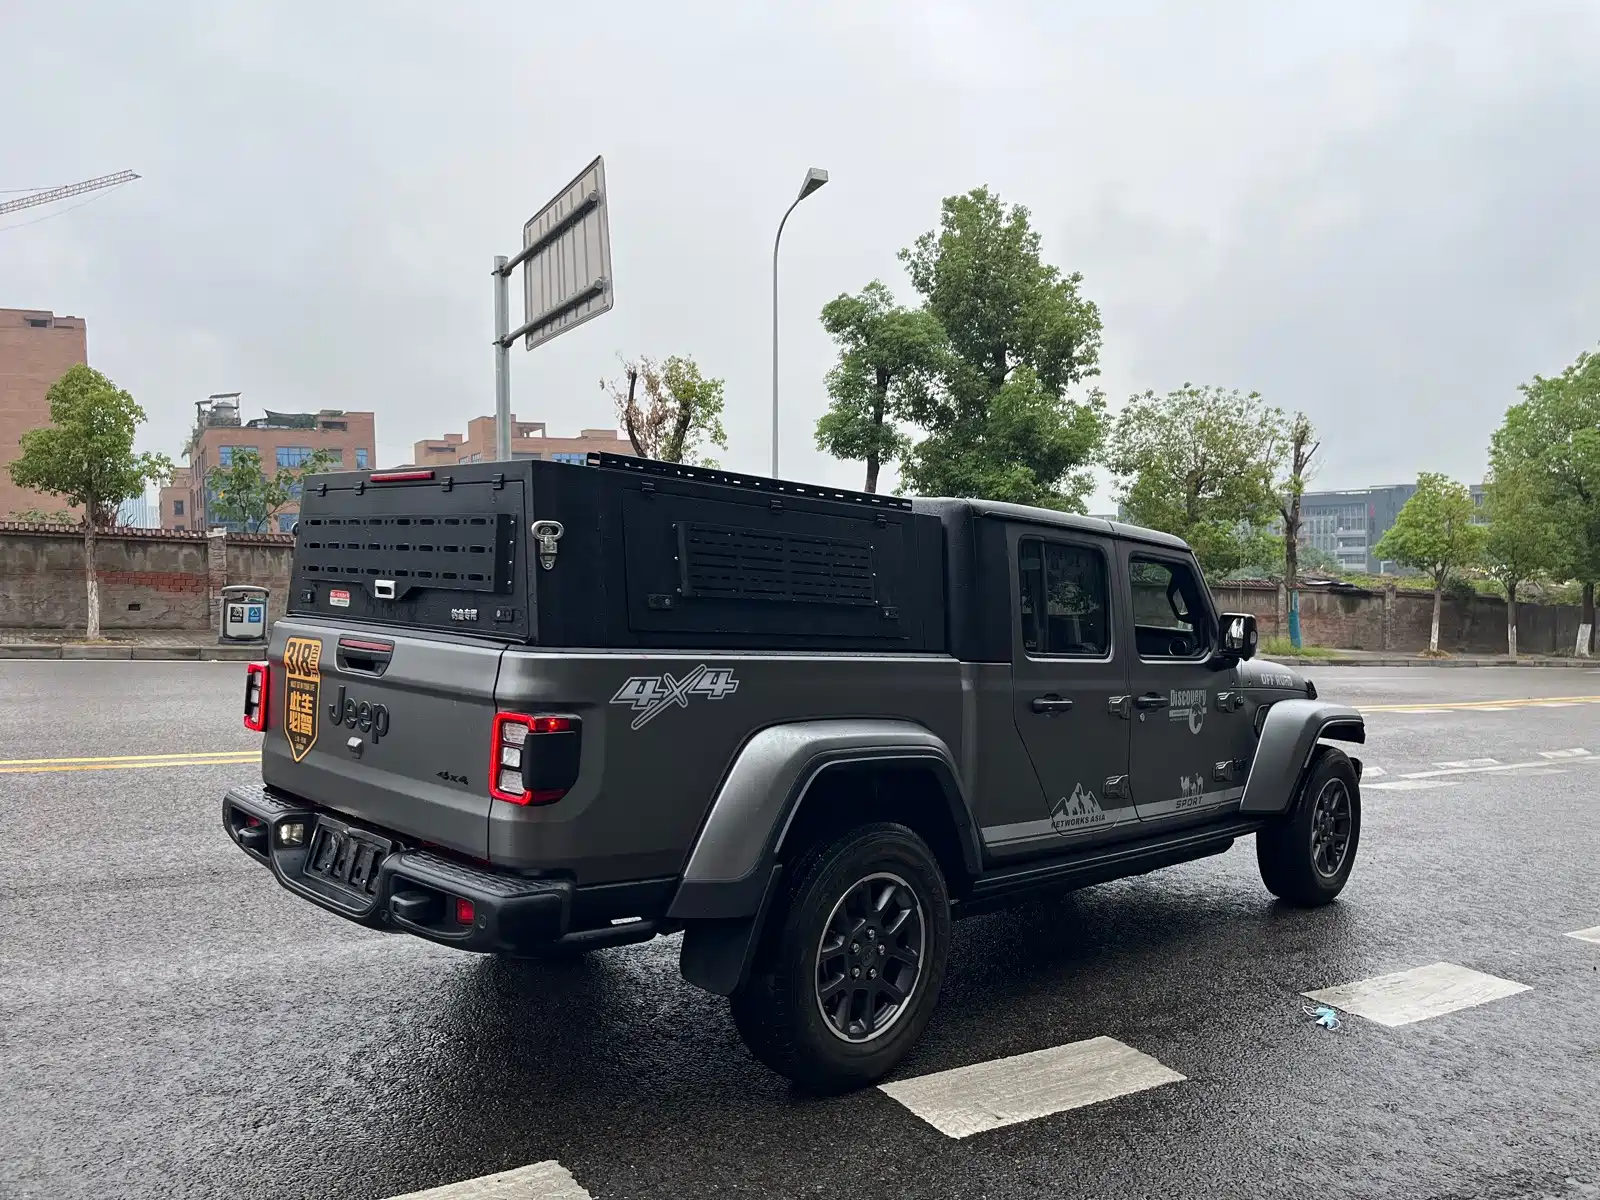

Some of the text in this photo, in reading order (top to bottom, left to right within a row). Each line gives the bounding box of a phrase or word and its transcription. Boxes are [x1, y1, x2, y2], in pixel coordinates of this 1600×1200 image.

[287, 641, 313, 678] 318
[309, 644, 320, 679] ROUTE
[1260, 673, 1274, 686] OFF
[328, 684, 390, 745] Jeep
[1175, 796, 1203, 809] SPORT
[1090, 814, 1106, 823] ASIA
